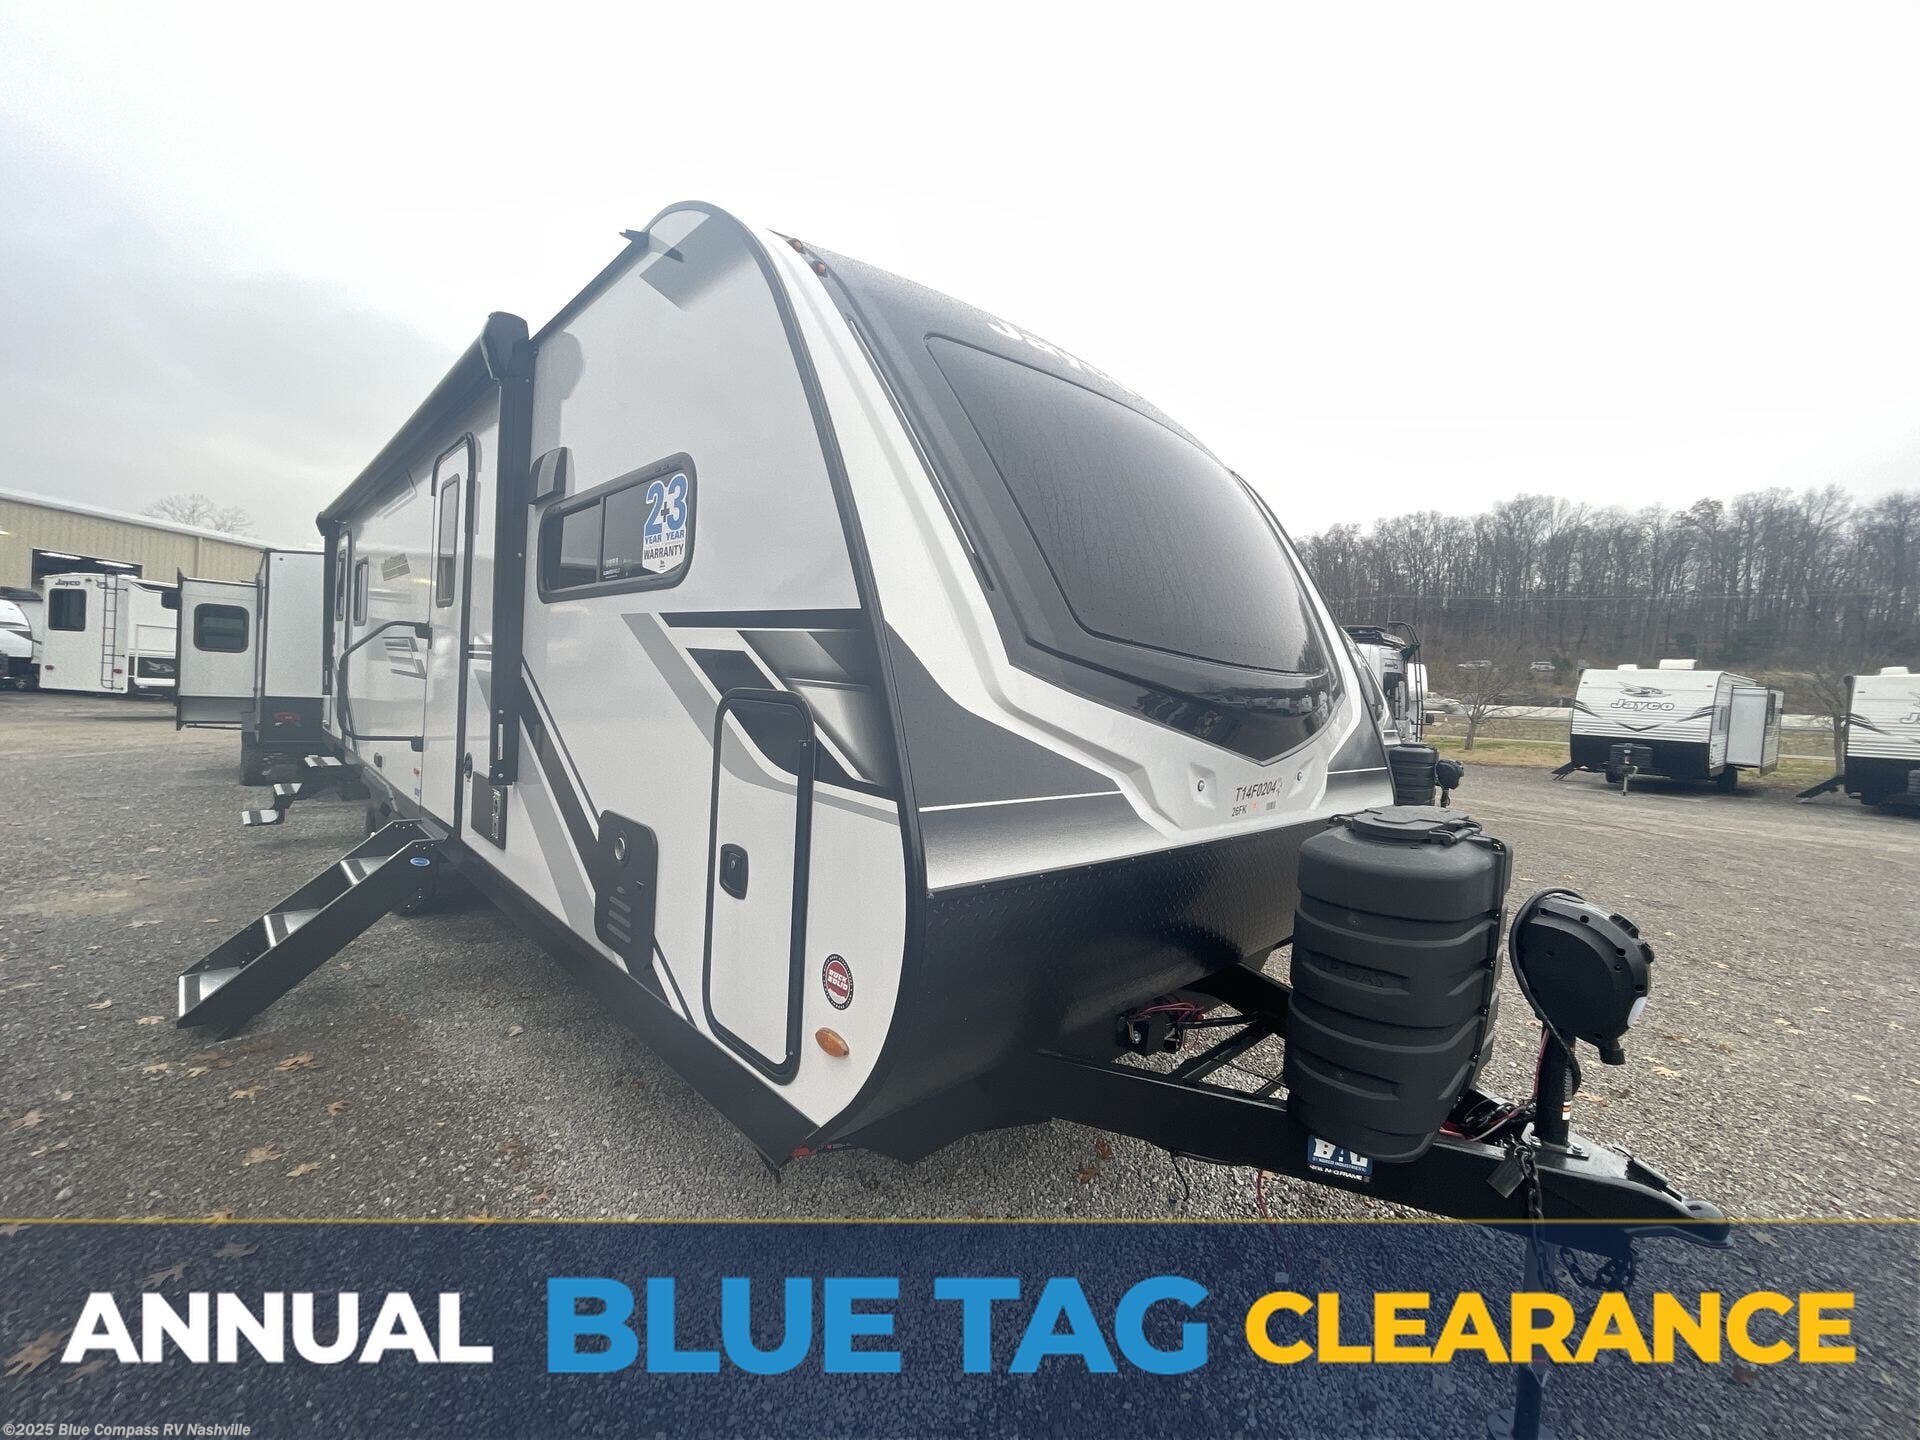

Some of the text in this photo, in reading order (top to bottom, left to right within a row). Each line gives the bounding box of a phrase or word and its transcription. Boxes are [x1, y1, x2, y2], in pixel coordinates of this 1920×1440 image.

[645, 530, 684, 545] YEAR YEAR
[644, 544, 684, 560] WARRANTY
[55, 578, 81, 587] Jayco
[1611, 699, 1675, 711] Jayco
[827, 975, 848, 991] SOLID
